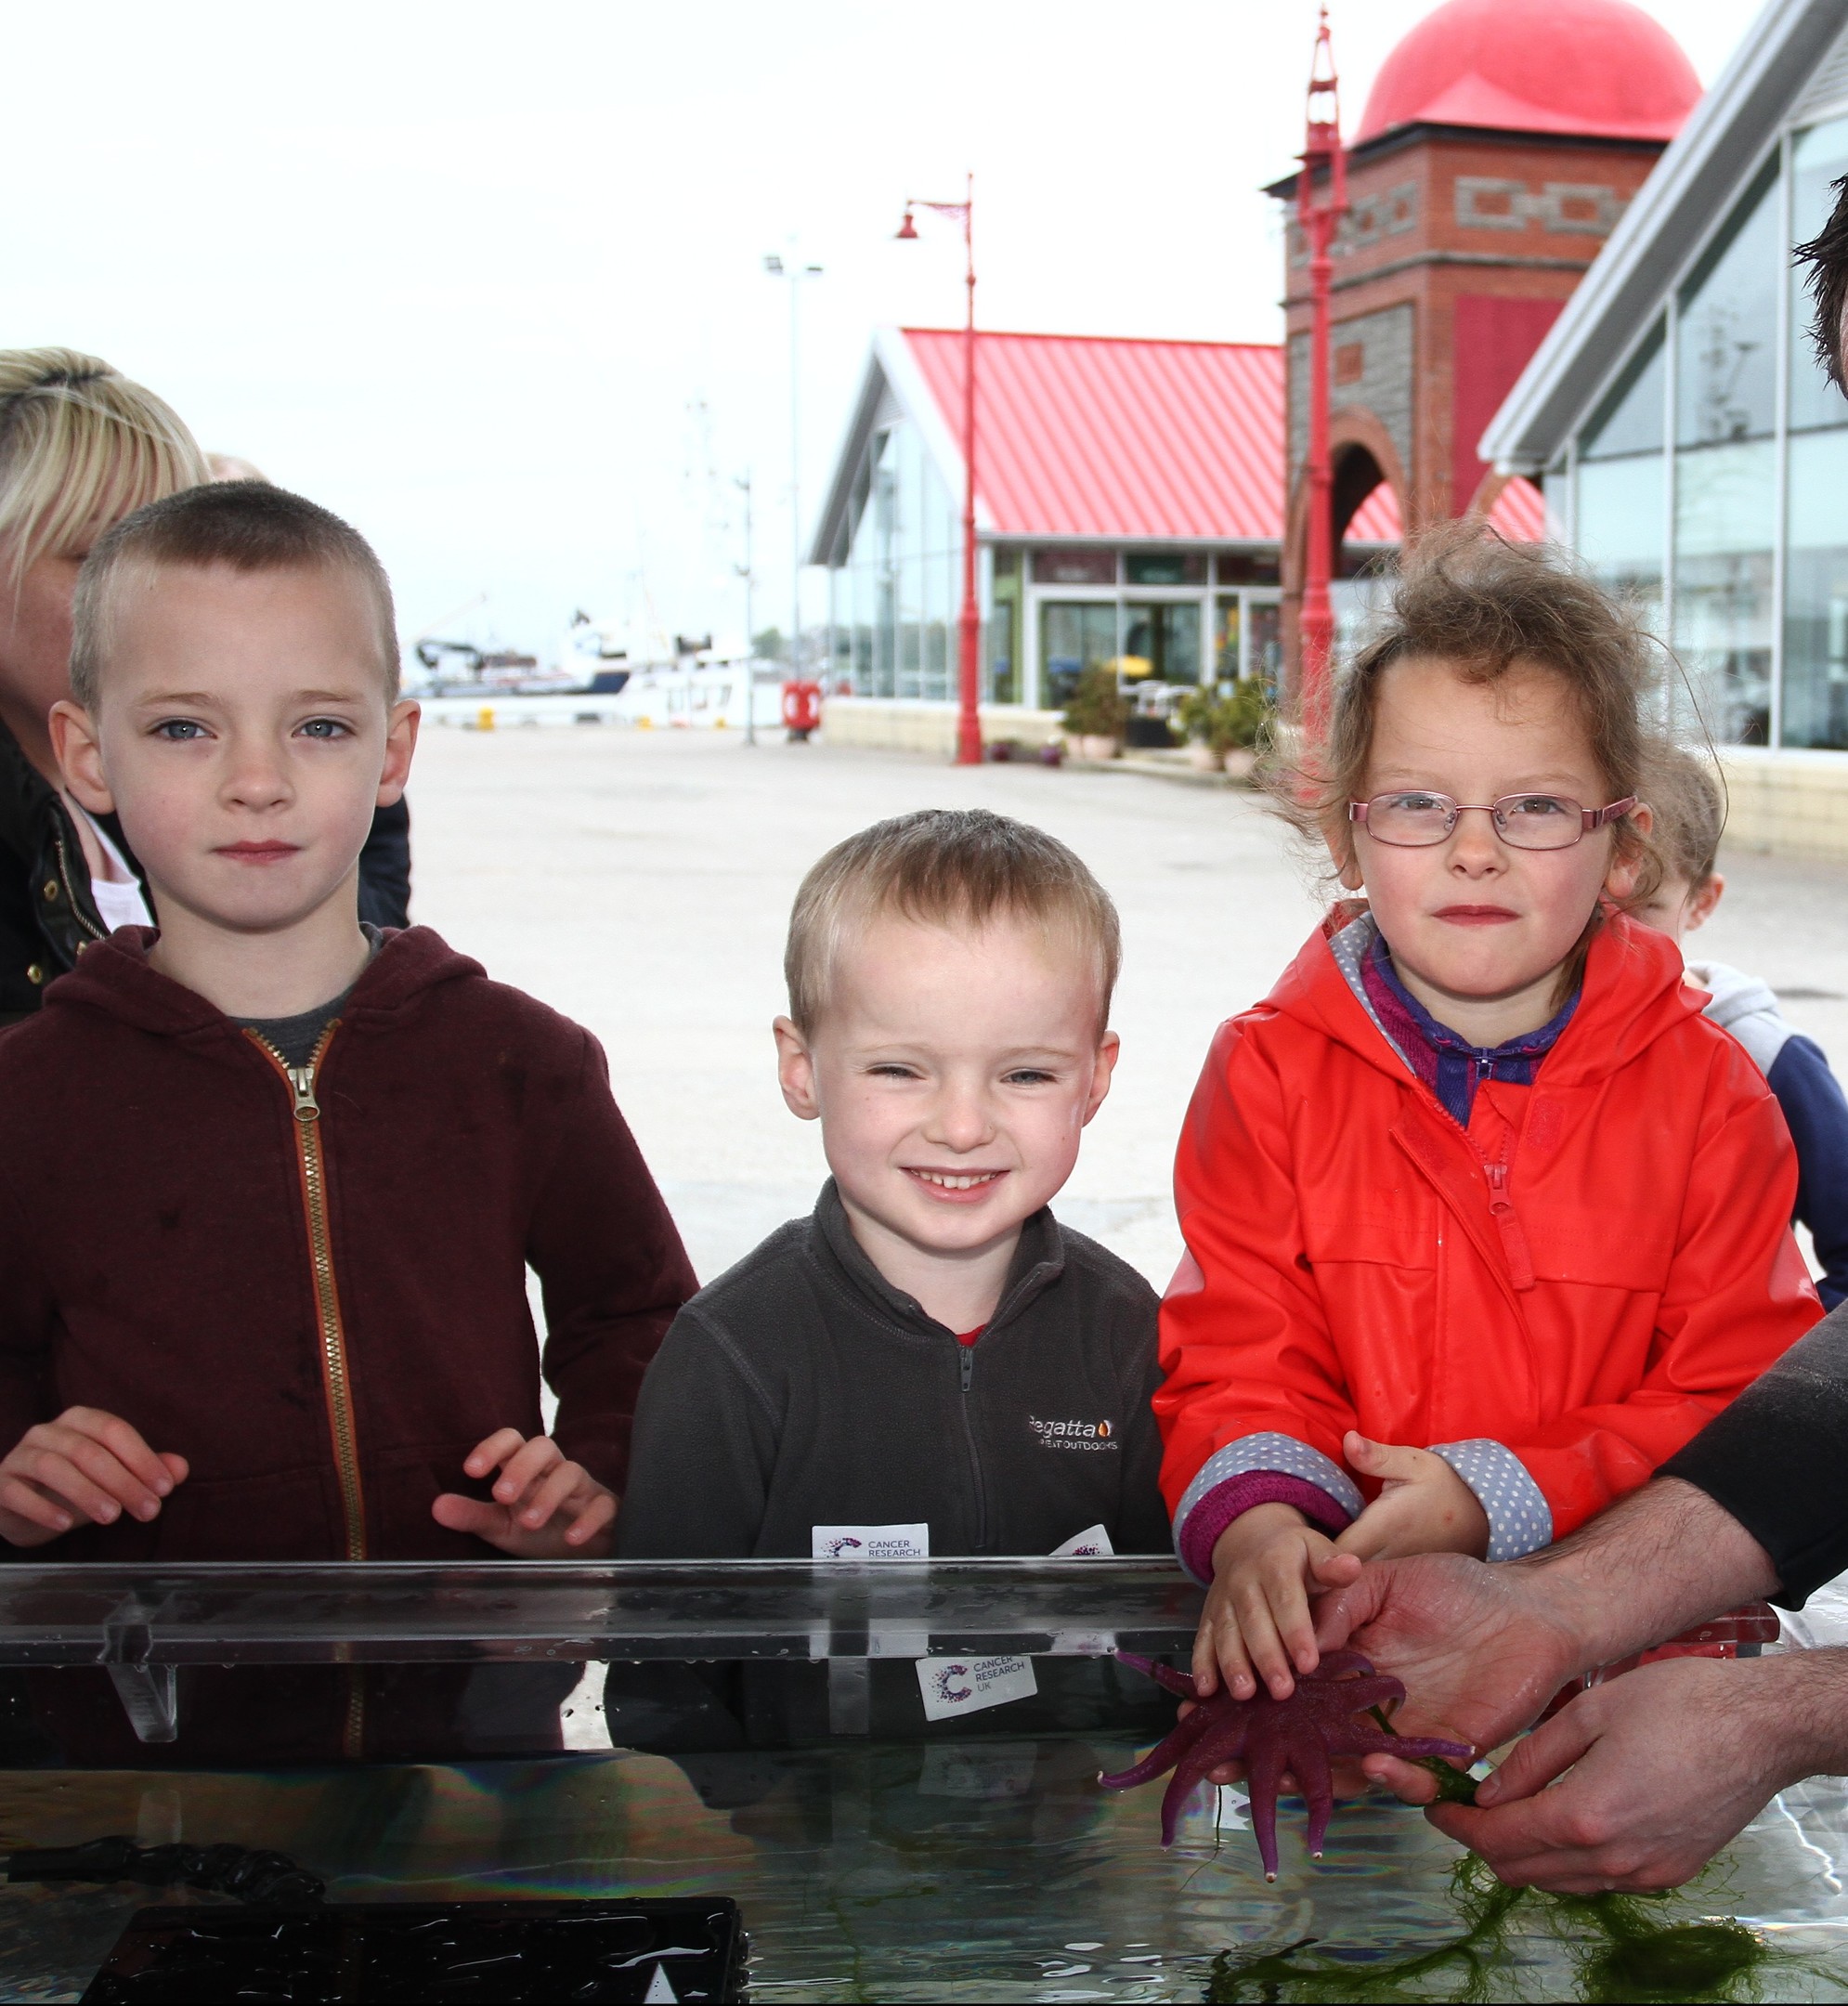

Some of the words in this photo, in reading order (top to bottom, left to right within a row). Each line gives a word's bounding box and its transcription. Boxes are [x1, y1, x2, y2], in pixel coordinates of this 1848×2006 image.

[867, 1540, 910, 1549] CANCER
[868, 1548, 921, 1557] RESEARCH
[973, 1656, 1013, 1672] CANCER
[975, 1661, 1025, 1682] RESEARCH
[977, 1681, 992, 1692] UK
